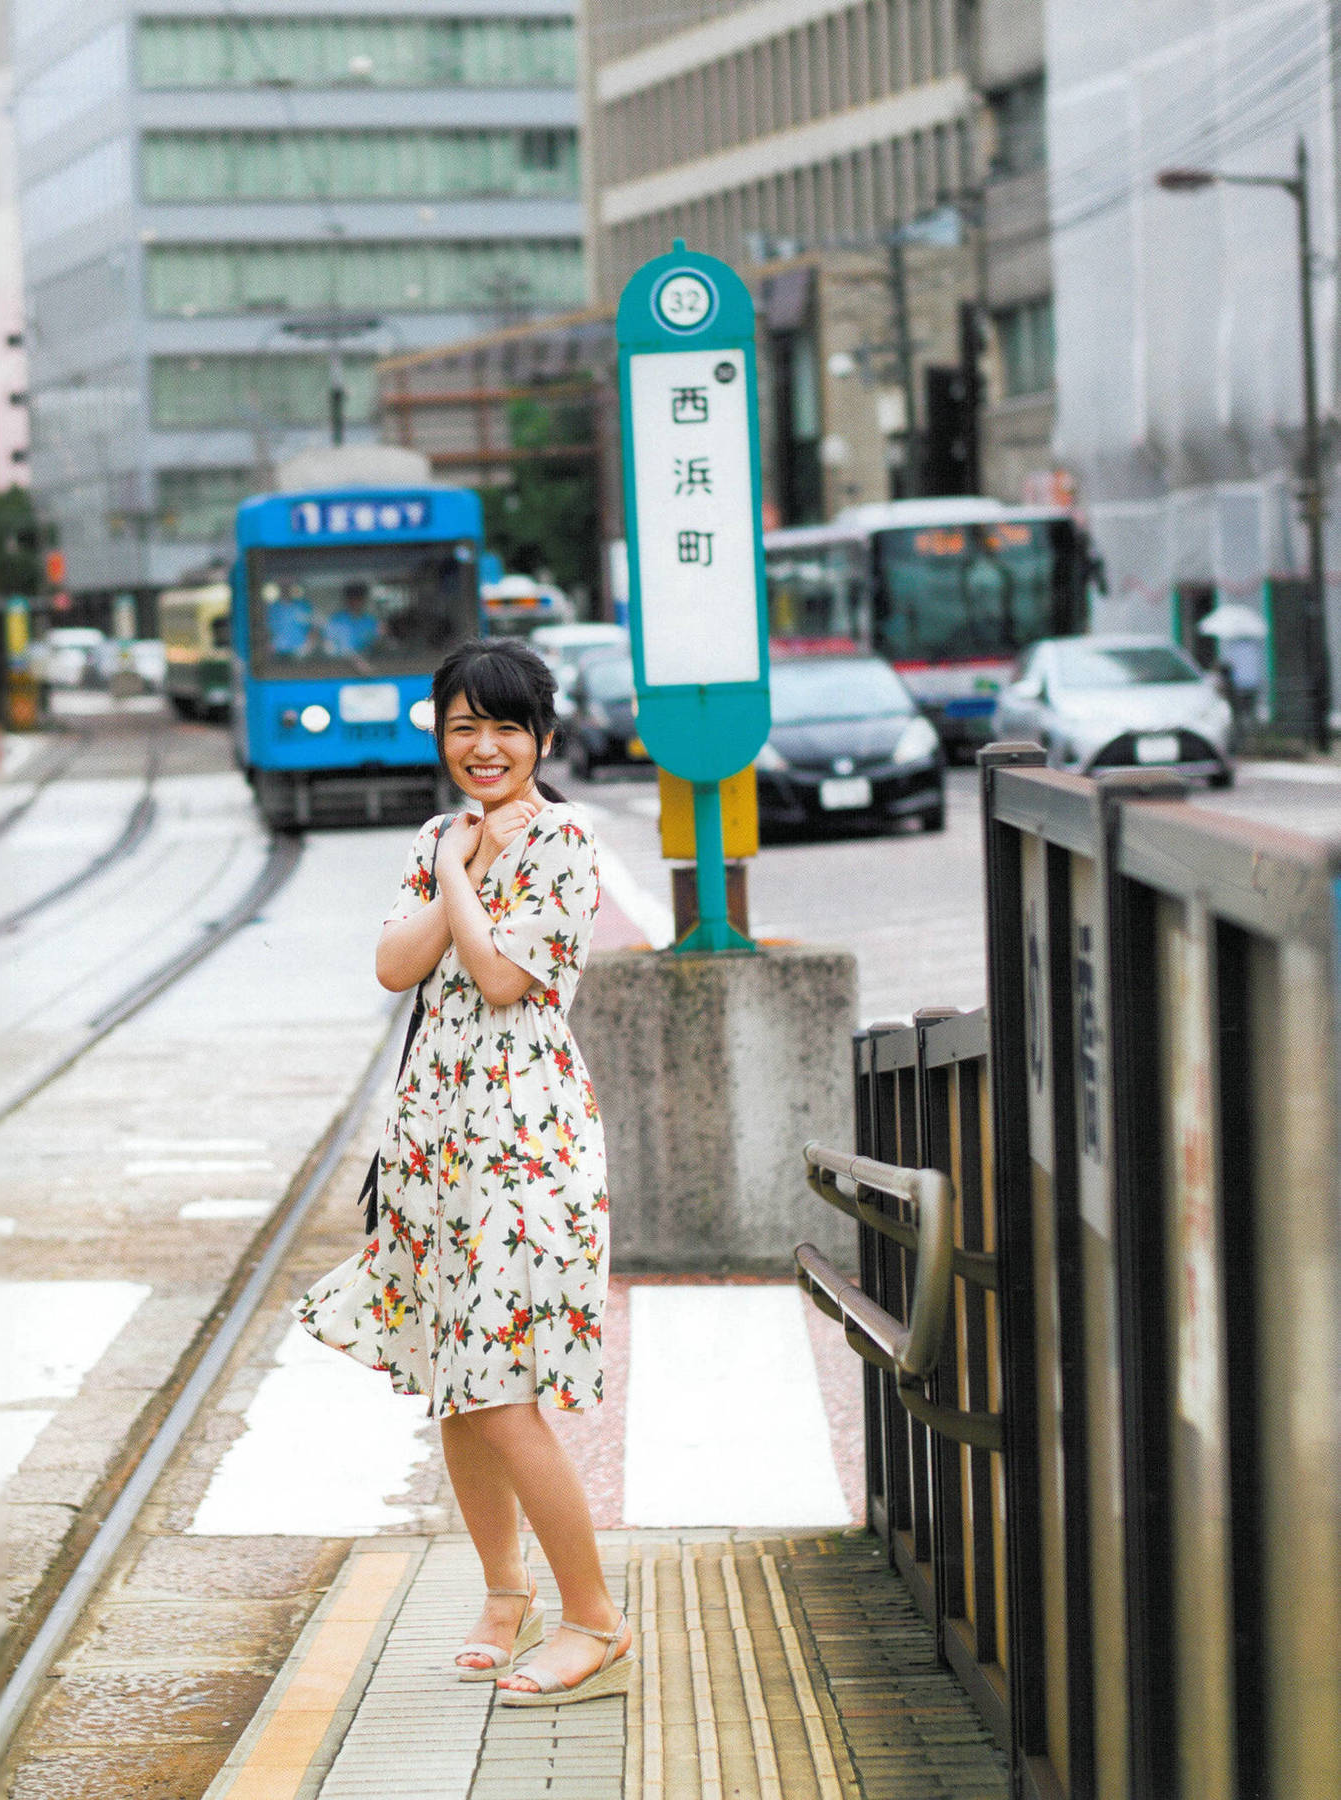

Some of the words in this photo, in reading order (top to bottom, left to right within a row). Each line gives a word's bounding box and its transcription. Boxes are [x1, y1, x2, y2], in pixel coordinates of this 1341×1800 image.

[669, 290, 701, 313] 32
[671, 386, 714, 567] 西浜町
